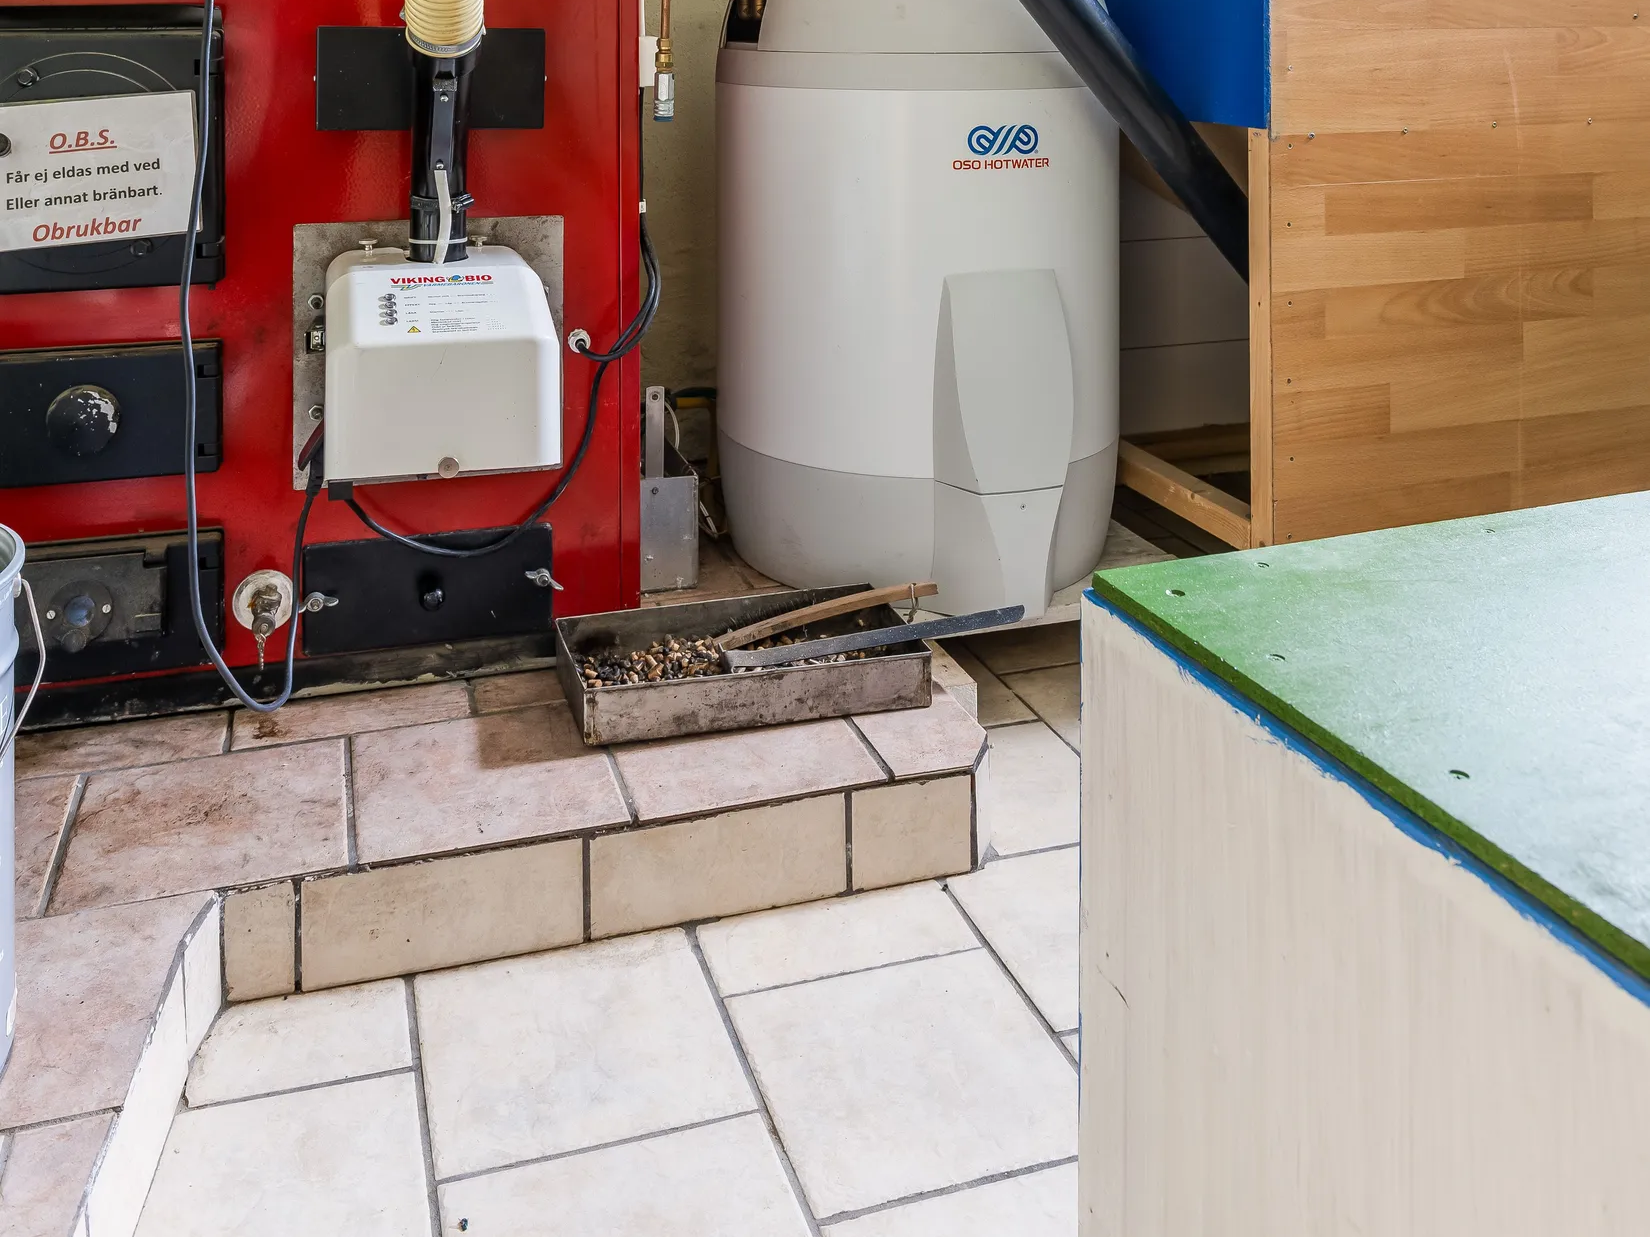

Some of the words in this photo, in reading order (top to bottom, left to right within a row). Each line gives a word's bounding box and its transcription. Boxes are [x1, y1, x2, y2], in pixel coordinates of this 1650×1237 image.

[50, 129, 115, 150] O.B.S.
[6, 170, 30, 184] Får
[34, 169, 48, 183] ej
[52, 165, 92, 180] eldas
[97, 161, 129, 175] med
[133, 158, 161, 172] ved
[952, 159, 981, 170] OSO
[984, 157, 1049, 170] HOTWATER
[6, 196, 40, 210] Eller
[44, 192, 88, 207] annat
[93, 184, 163, 202] bränbart.
[32, 217, 142, 242] Obrukbar
[390, 276, 446, 285] VIKING
[465, 274, 493, 282] BIO
